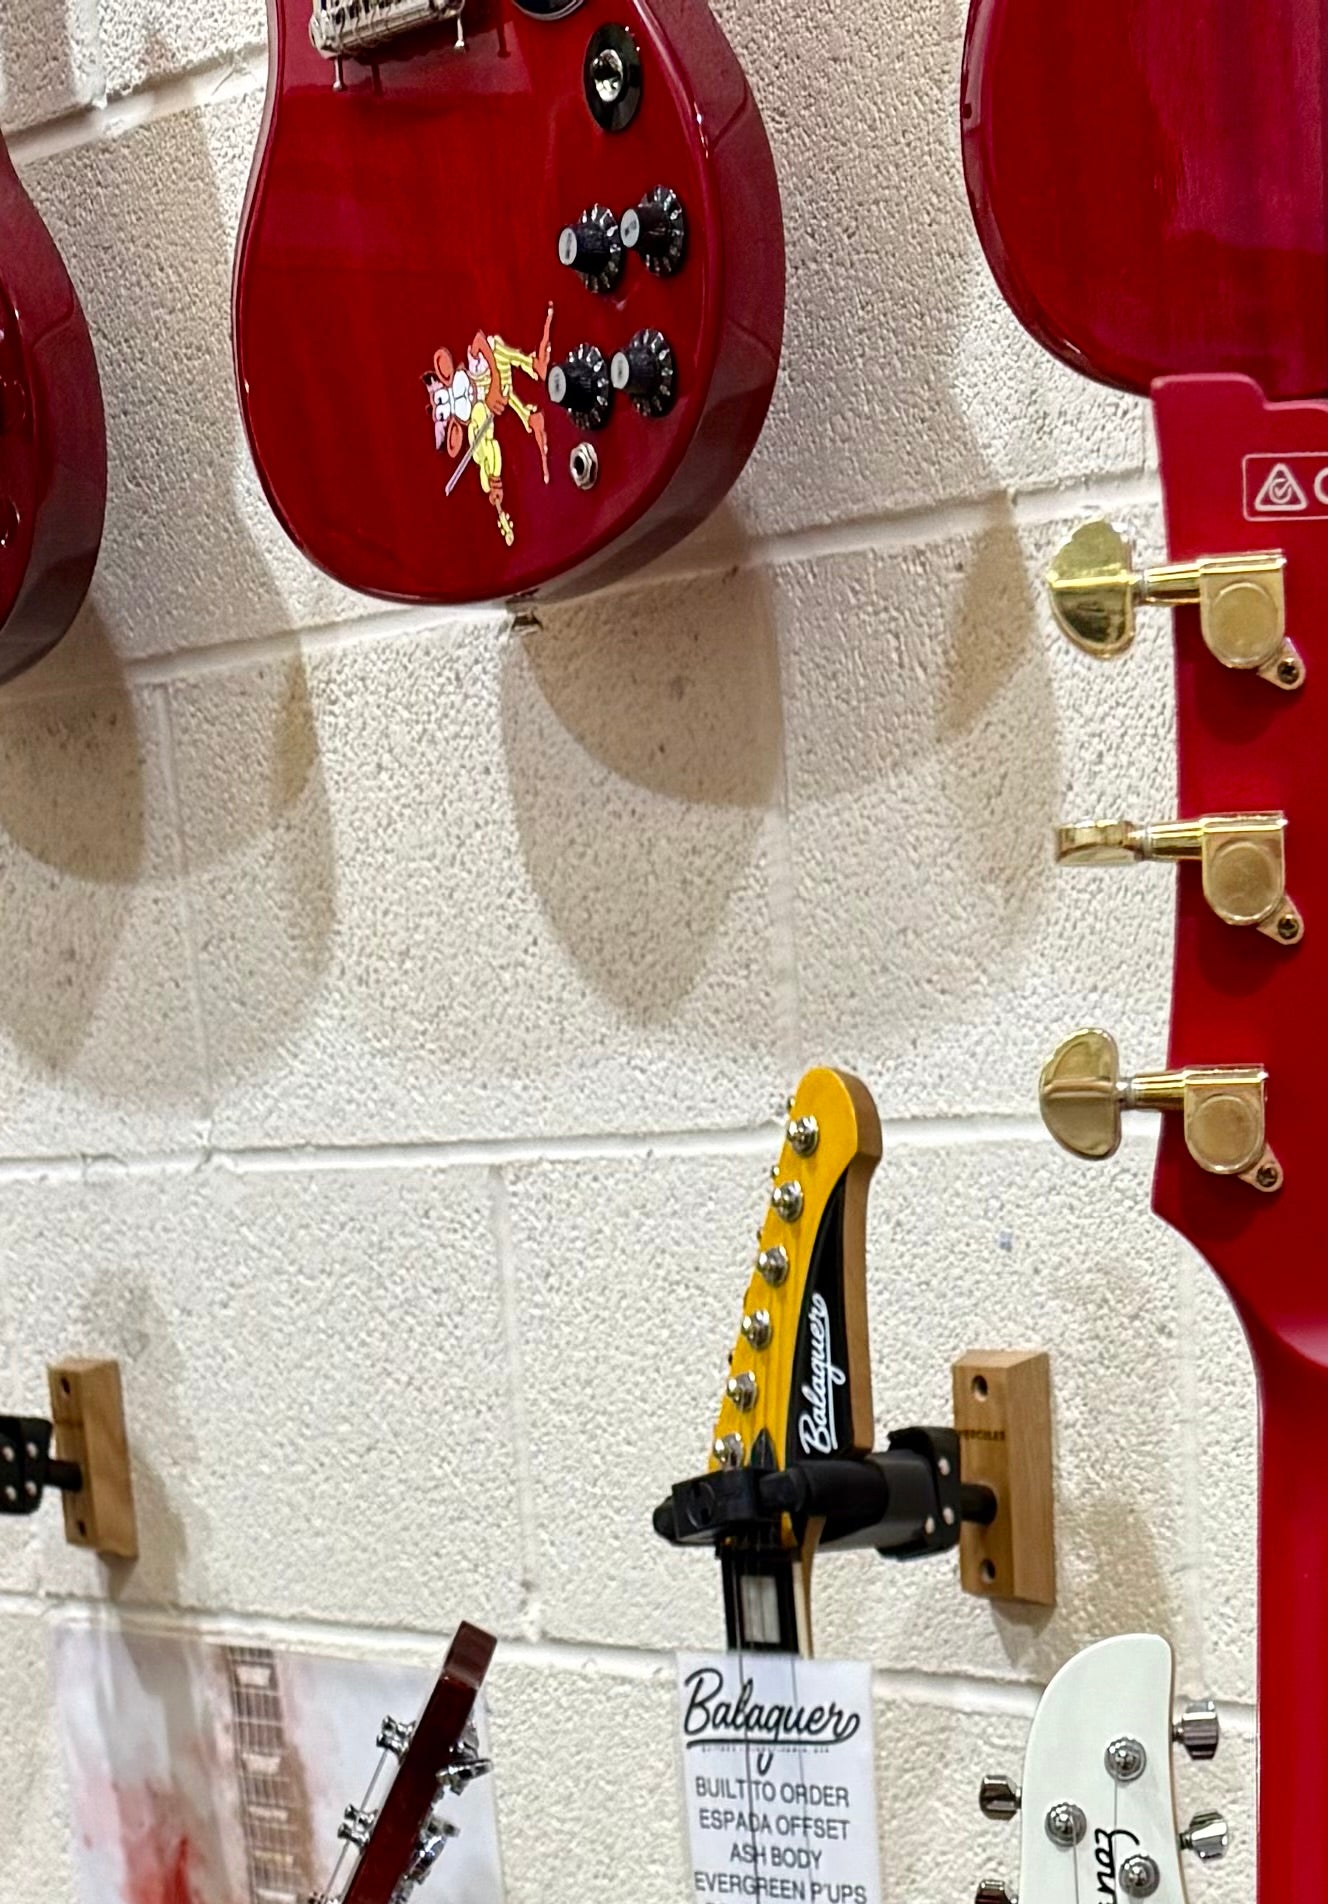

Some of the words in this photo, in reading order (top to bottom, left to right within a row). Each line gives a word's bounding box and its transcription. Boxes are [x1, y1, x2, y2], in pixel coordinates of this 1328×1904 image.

[799, 1293, 846, 1454] Balaguer
[684, 1668, 860, 1776] Balaguer
[696, 1777, 746, 1799] BUILT
[750, 1780, 776, 1801] TO
[780, 1783, 850, 1808] ORDER
[700, 1810, 772, 1835] ESPADA
[776, 1814, 850, 1840] OFFSET
[730, 1844, 766, 1865] ASH
[770, 1848, 822, 1870] BODY
[694, 1872, 805, 1900] EVERGREEN
